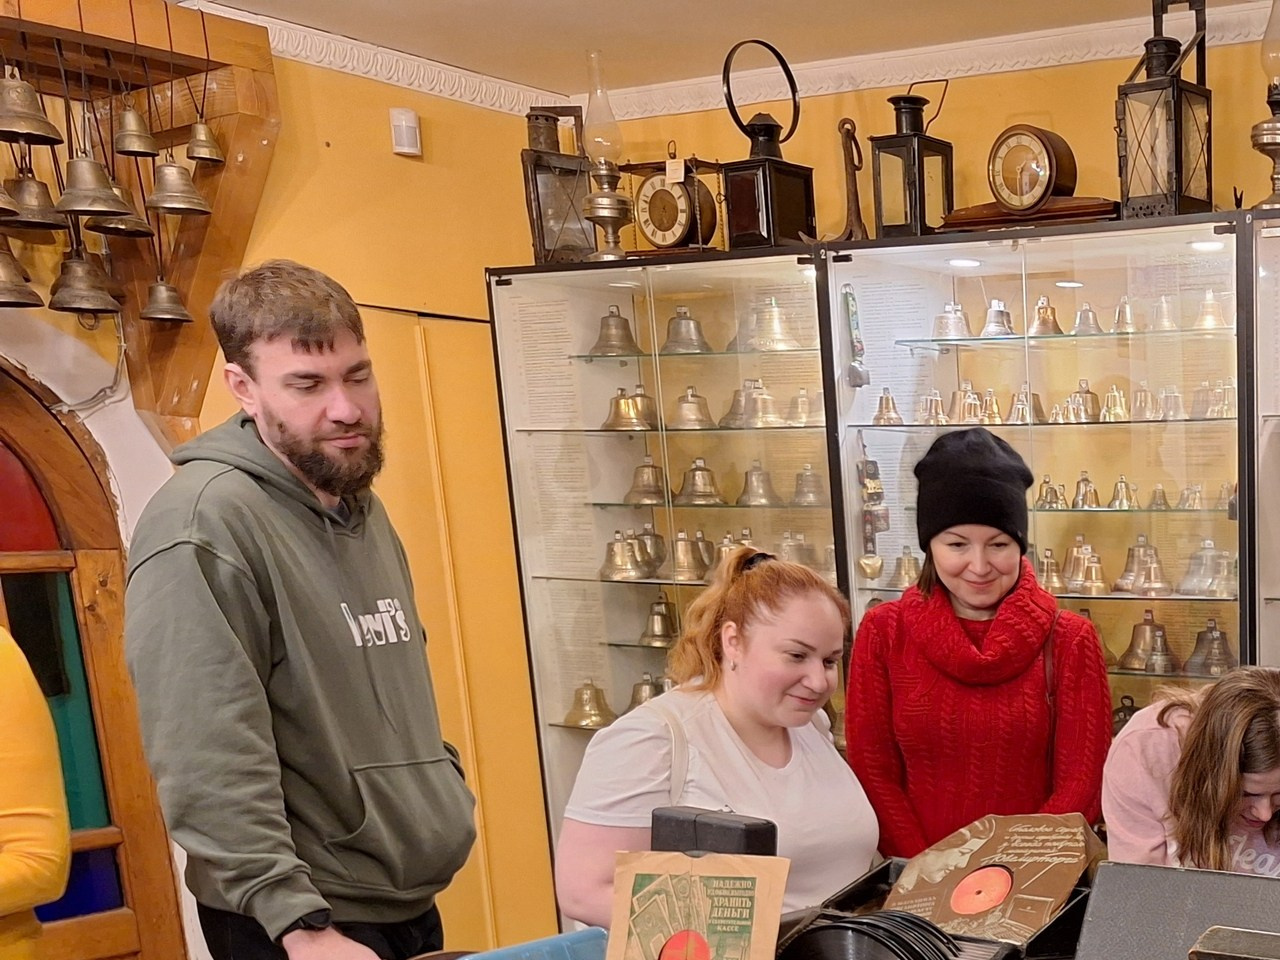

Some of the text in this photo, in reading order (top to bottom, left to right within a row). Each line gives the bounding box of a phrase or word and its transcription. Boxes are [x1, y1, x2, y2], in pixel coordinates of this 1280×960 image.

[819, 249, 827, 259] 2
[713, 897, 752, 908] ХРАНИТЬ
[710, 907, 750, 918] ДЕНЬГИ
